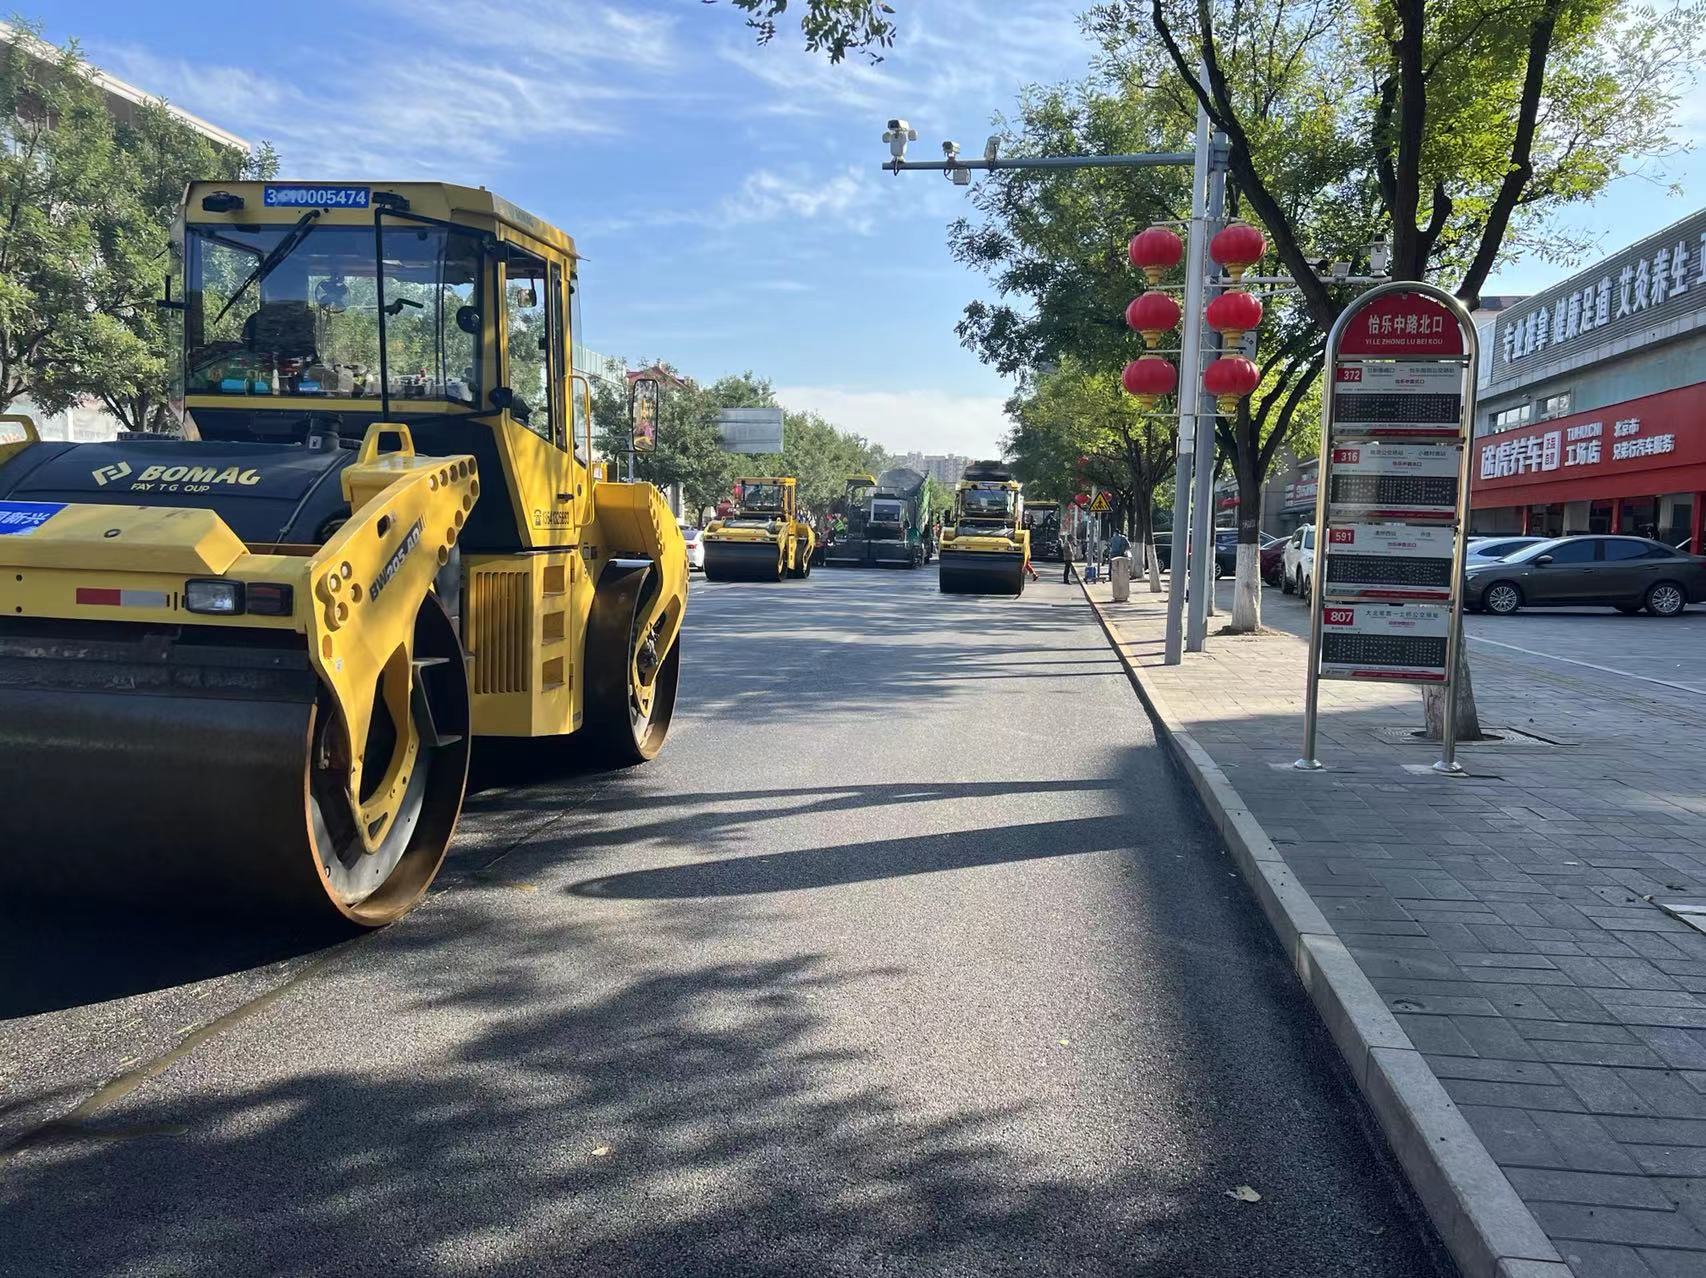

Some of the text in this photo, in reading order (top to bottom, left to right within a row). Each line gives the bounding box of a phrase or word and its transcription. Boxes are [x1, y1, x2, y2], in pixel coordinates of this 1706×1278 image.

[1368, 314, 1443, 335] 怡乐中路北口
[1344, 370, 1360, 380] 372
[1614, 418, 1640, 438] 北京市
[1341, 451, 1358, 462] 316
[1480, 436, 1544, 480] 途虎养车
[1565, 441, 1602, 467] 工场店
[138, 465, 262, 486] BOMAG
[1335, 531, 1352, 542] 591
[1330, 611, 1353, 622] 807
